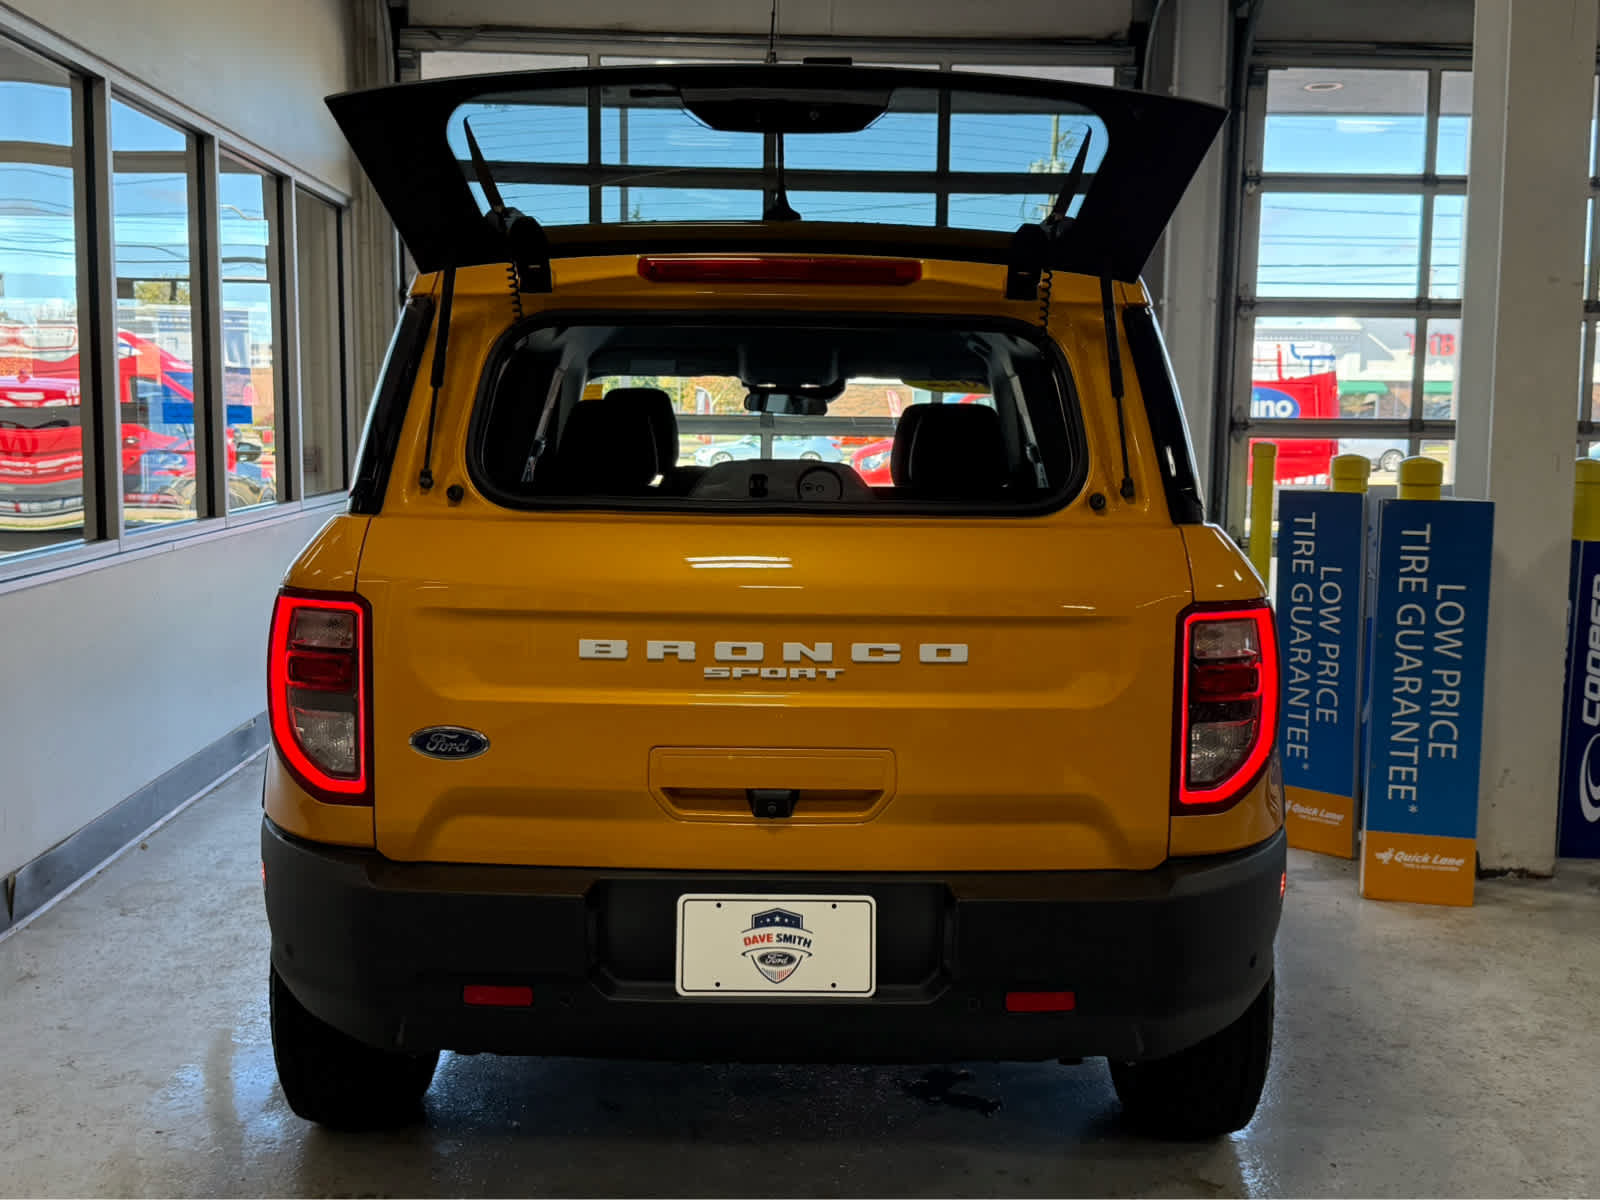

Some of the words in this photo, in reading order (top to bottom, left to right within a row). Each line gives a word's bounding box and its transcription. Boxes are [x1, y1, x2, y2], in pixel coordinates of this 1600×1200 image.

[1251, 392, 1294, 418] ino
[1292, 512, 1316, 575] TIRE
[1398, 523, 1431, 593] TIRE
[1320, 567, 1342, 634] LOW
[1434, 585, 1466, 659] LOW
[579, 639, 968, 663] BRONCO
[703, 667, 845, 680] SPORT
[1316, 642, 1340, 724] PRICE
[1428, 669, 1461, 759] PRICE
[1394, 851, 1430, 864] Quick
[1432, 854, 1464, 867] Lane
[743, 933, 773, 947] DAVE
[776, 933, 812, 948] SMITH
